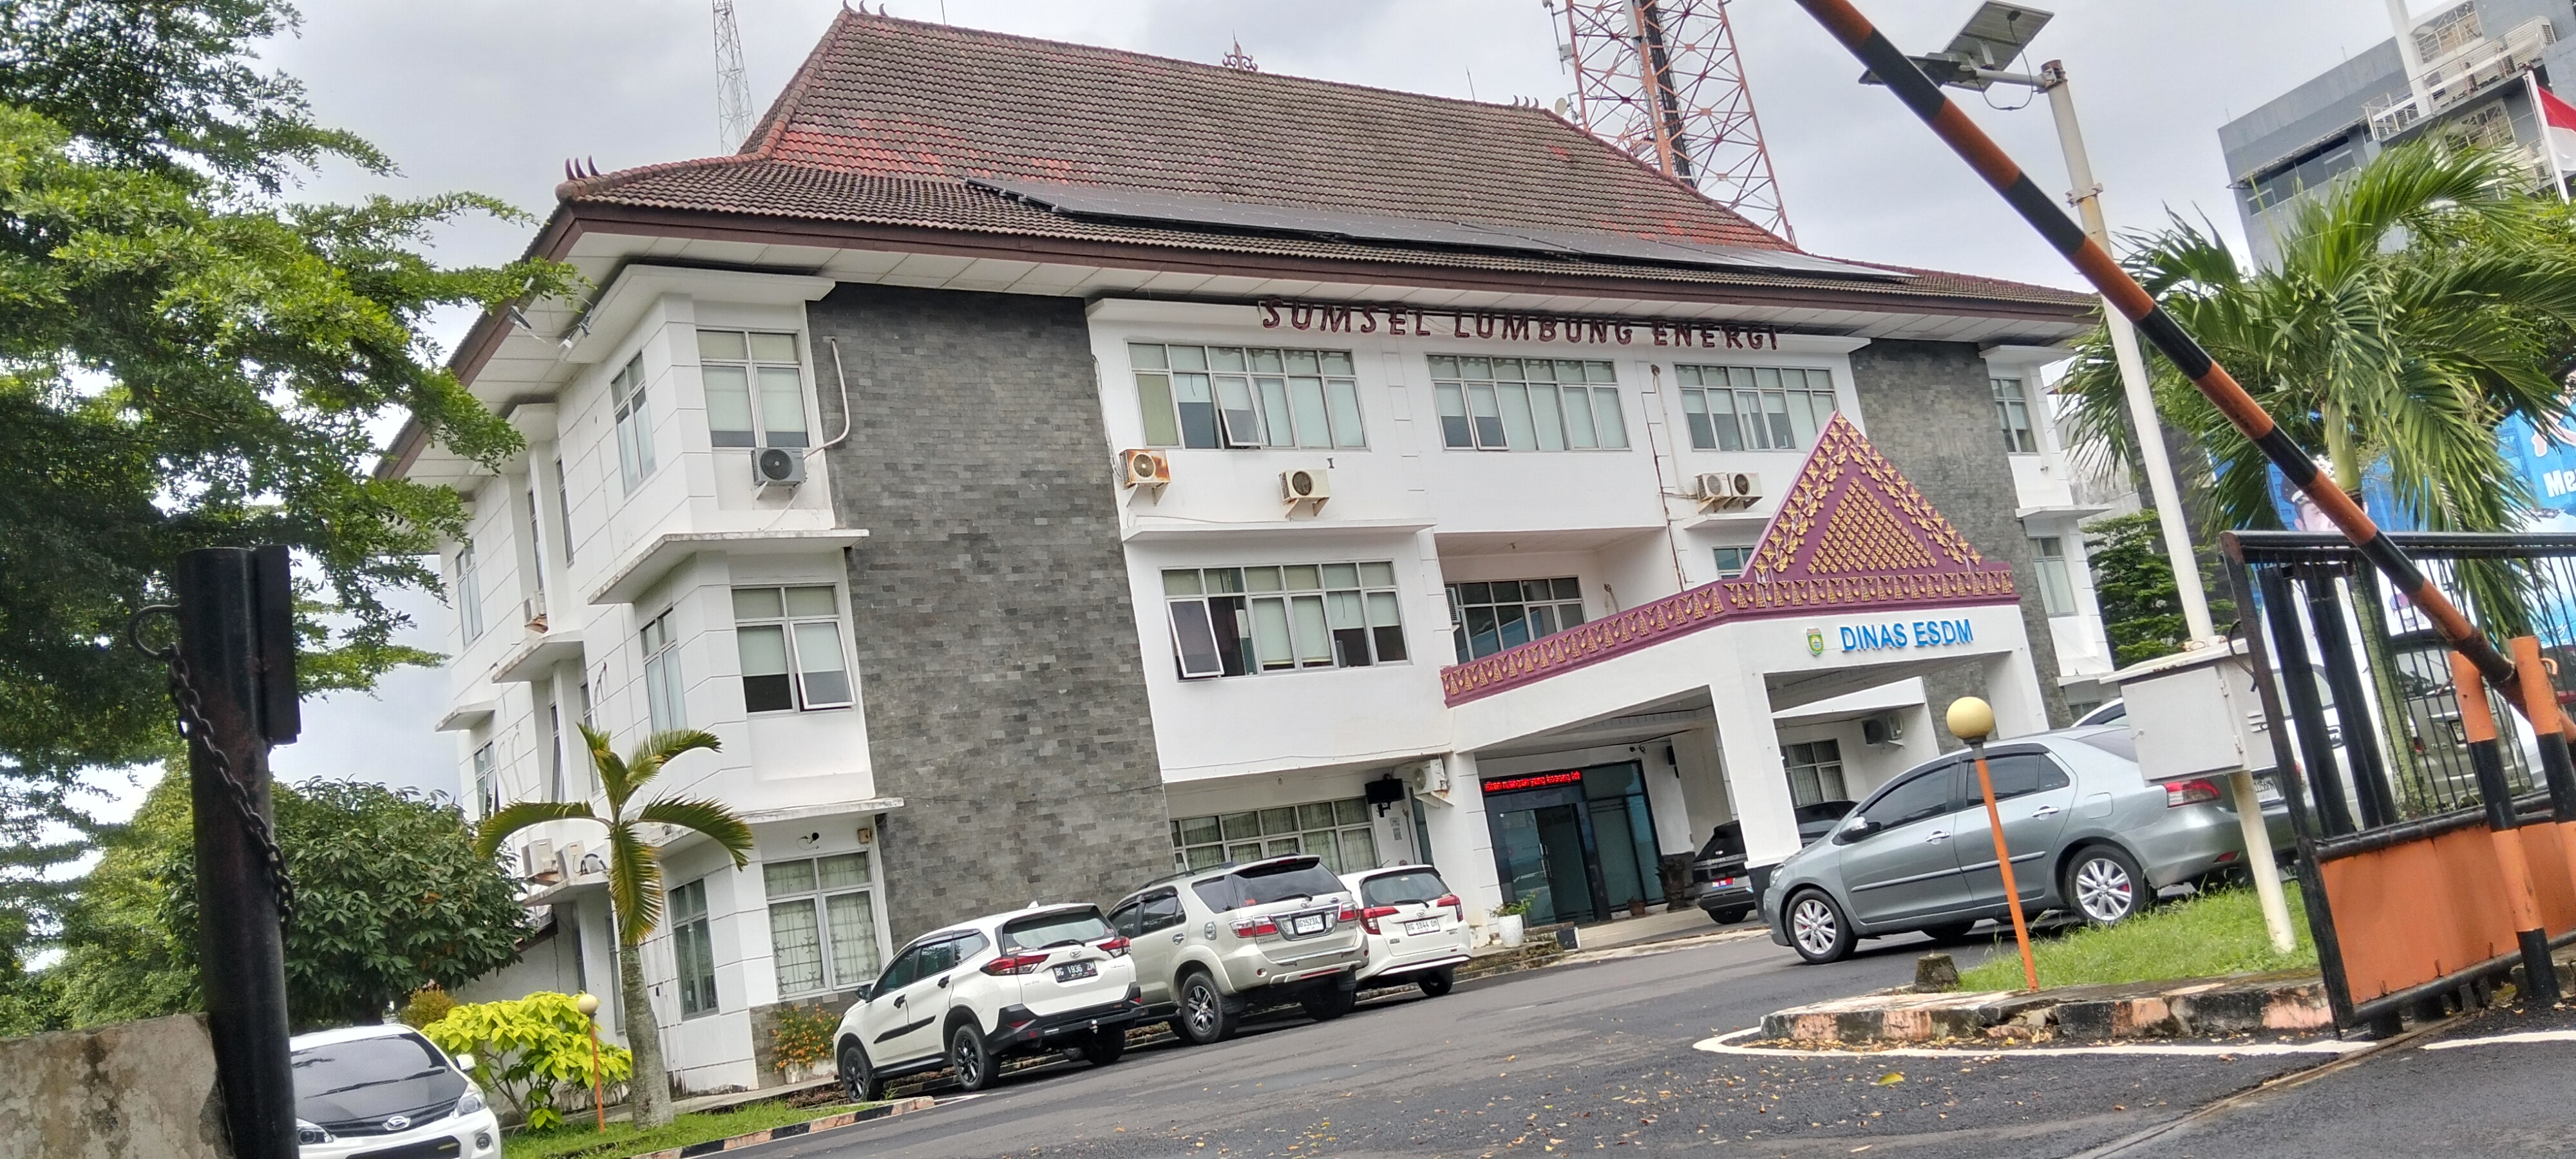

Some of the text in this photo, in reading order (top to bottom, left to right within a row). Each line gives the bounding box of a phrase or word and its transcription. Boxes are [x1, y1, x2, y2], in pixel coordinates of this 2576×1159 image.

[1263, 297, 1777, 350] SUMSEL LUMBUNG ENERGI
[2543, 468, 2576, 498] Me
[1839, 619, 1973, 651] DINAS ESDM
[1055, 966, 1064, 976] BG
[1066, 965, 1083, 974] 1936
